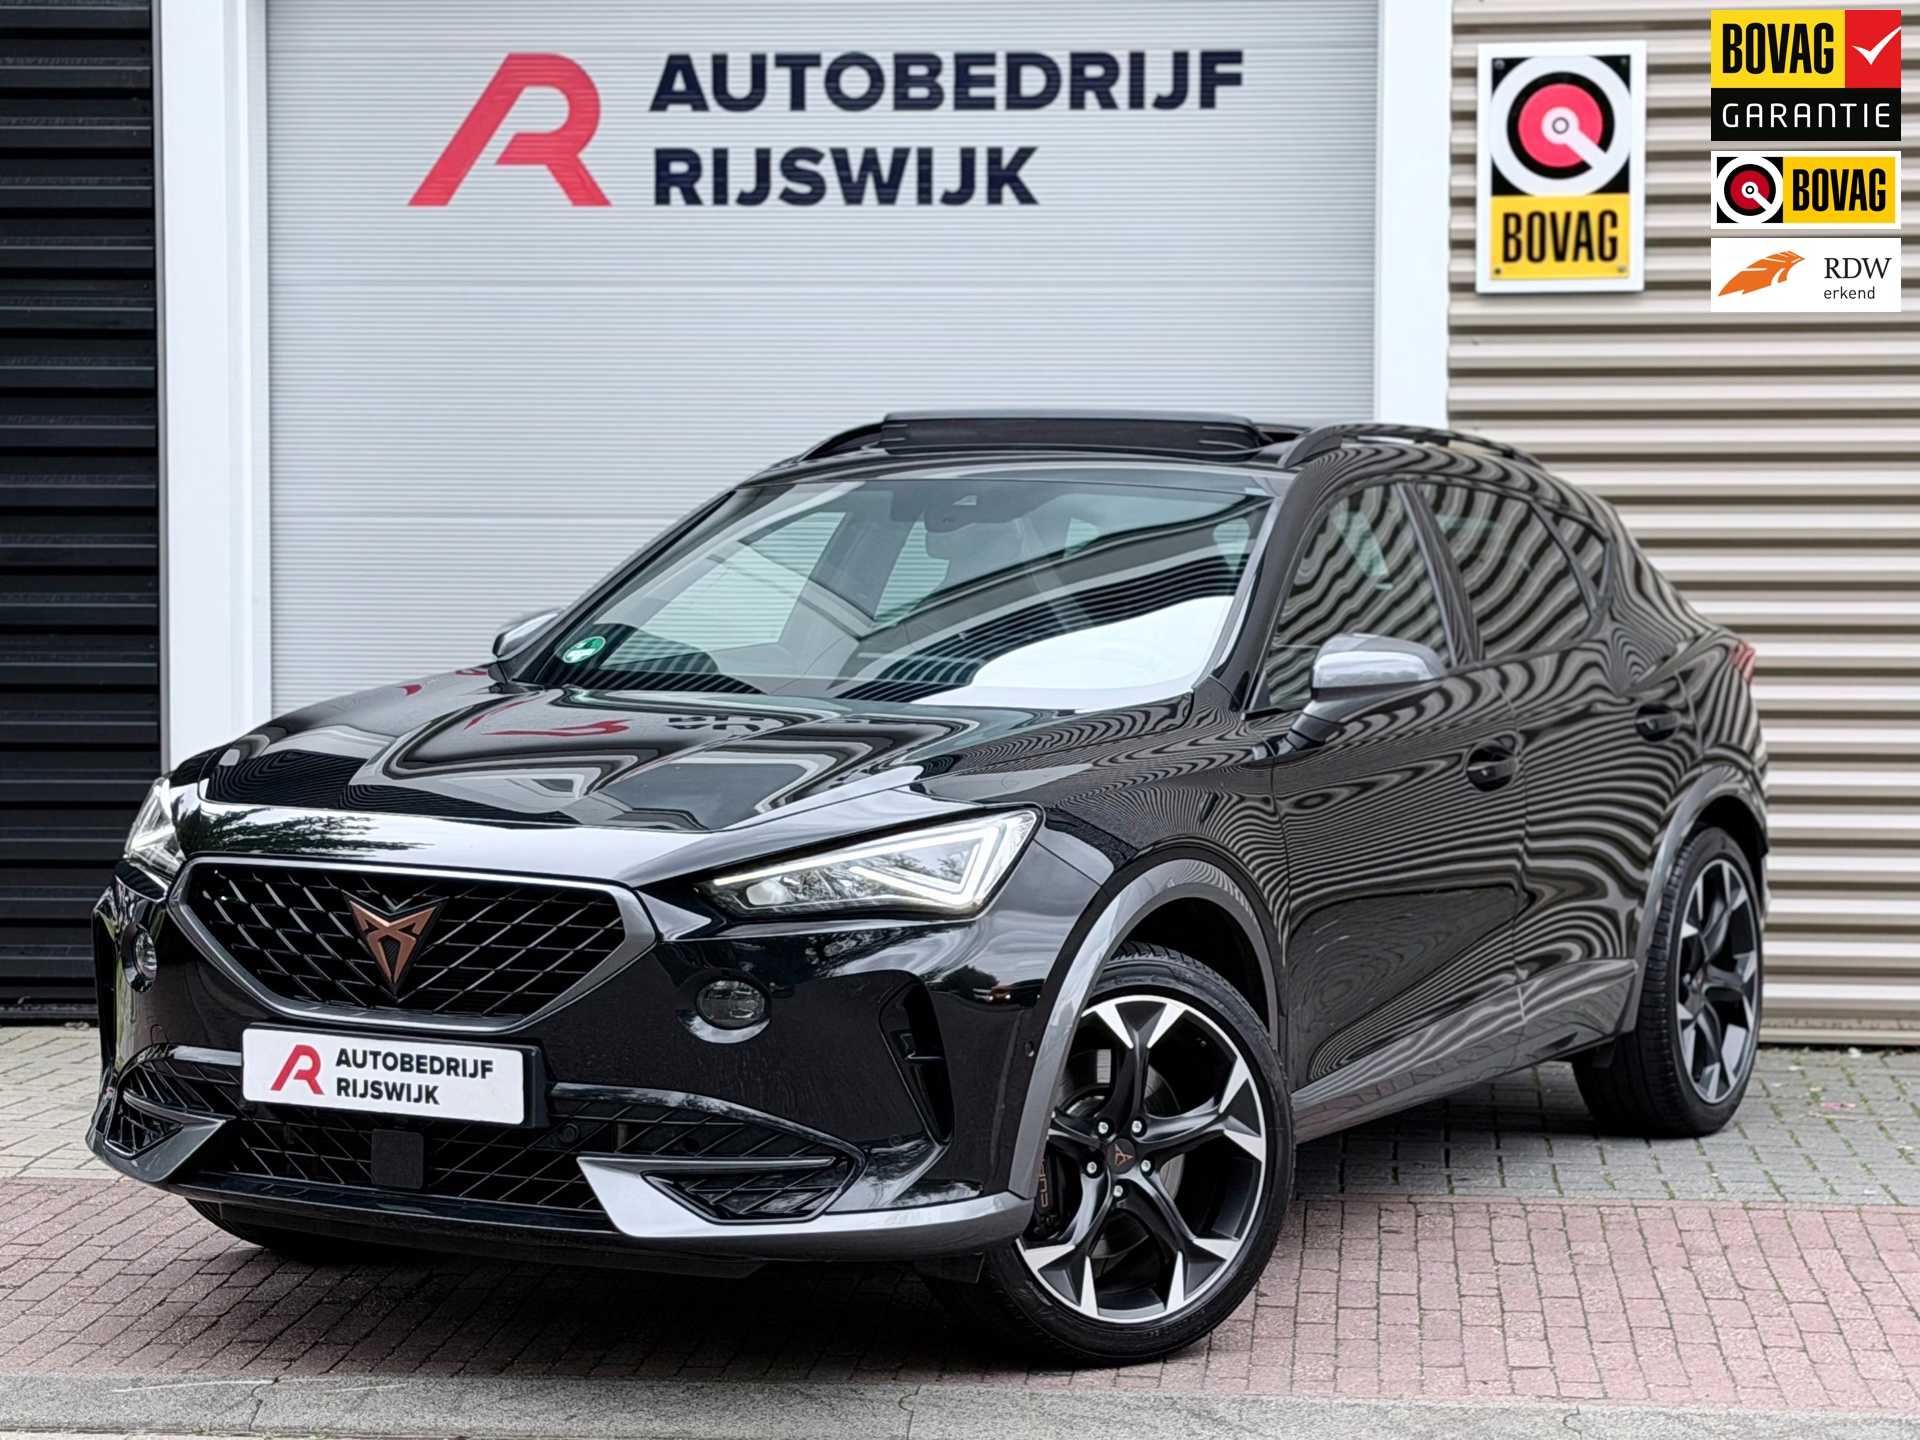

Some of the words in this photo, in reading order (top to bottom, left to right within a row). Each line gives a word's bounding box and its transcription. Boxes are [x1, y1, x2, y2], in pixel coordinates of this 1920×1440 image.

[649, 50, 1244, 112] AUTOBEDRIJF
[653, 147, 1039, 206] RIJSWIJK
[1502, 209, 1618, 263] BOVAG
[335, 1048, 494, 1079] AUTOBEDRIJF
[336, 1077, 440, 1105] RIJSWIJK
